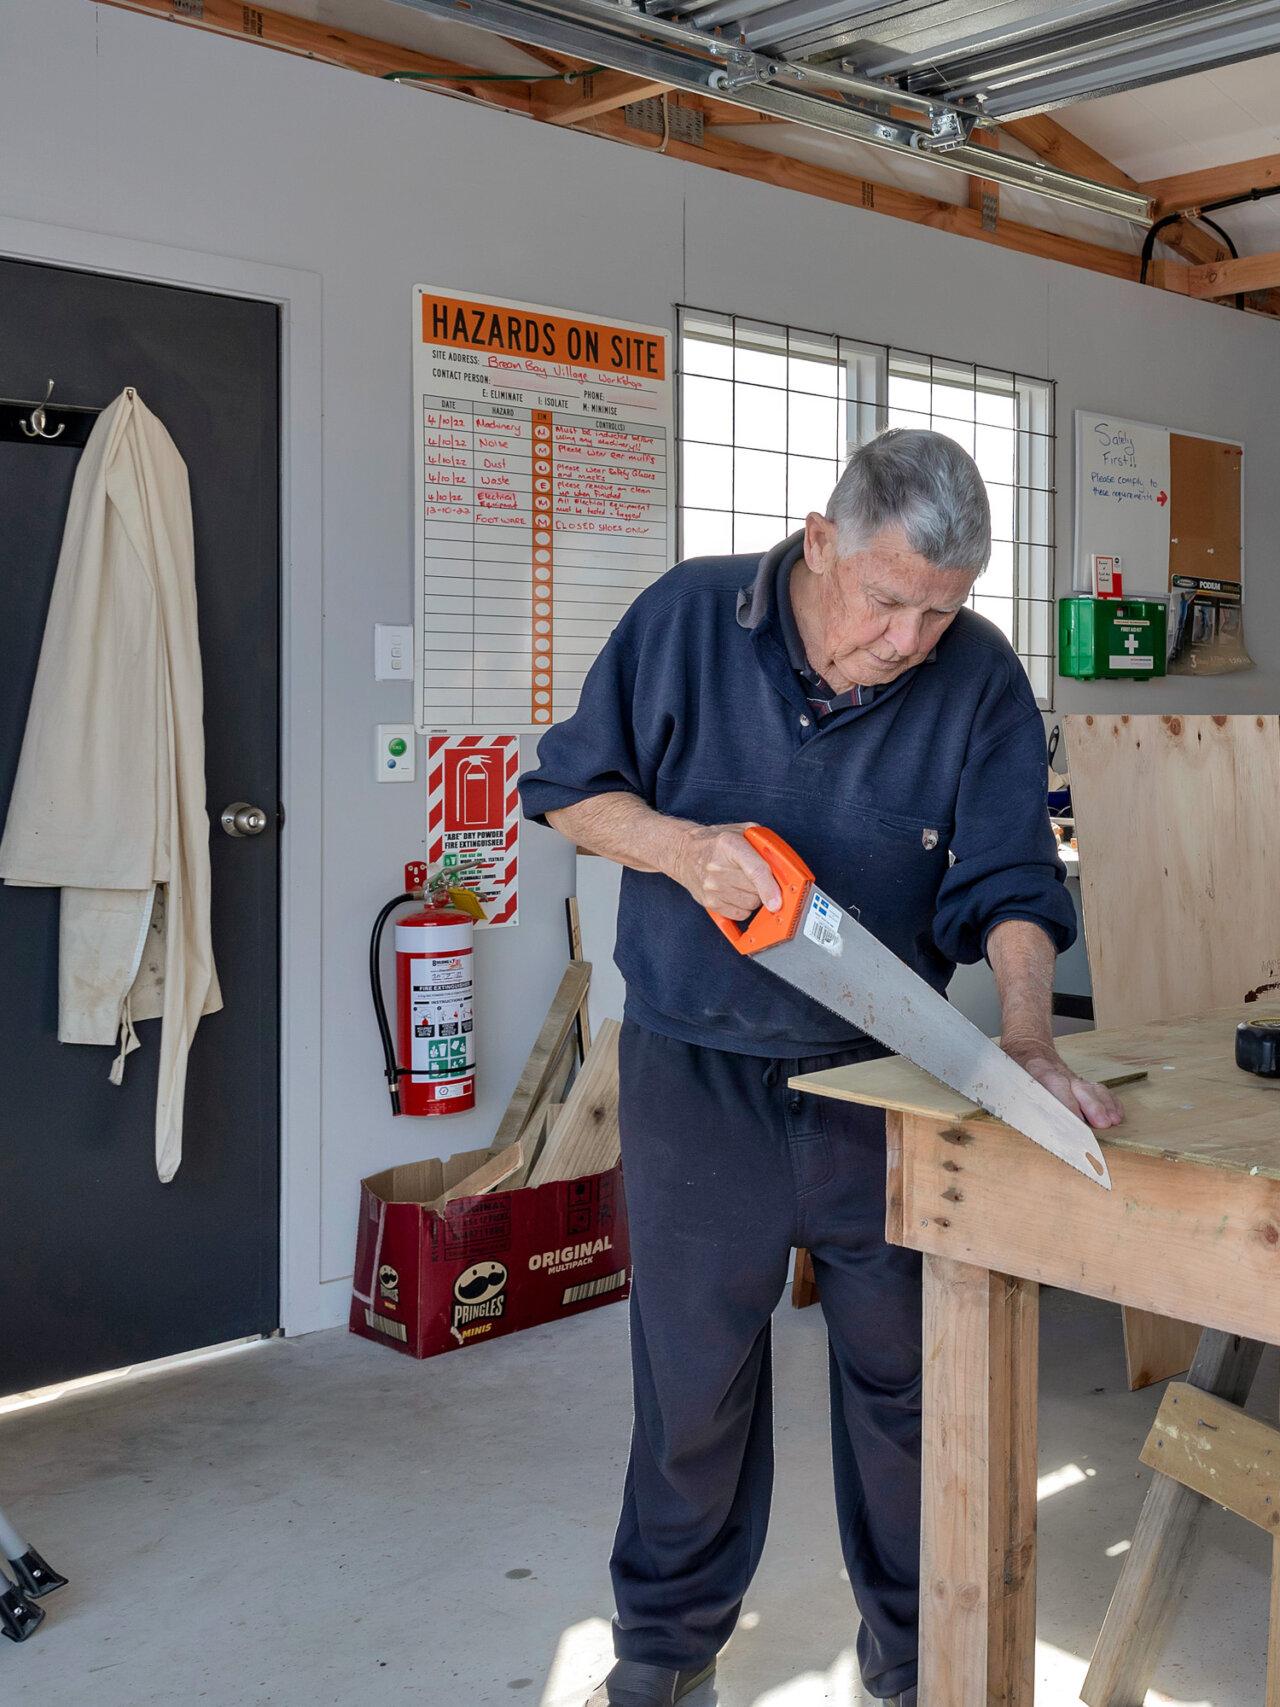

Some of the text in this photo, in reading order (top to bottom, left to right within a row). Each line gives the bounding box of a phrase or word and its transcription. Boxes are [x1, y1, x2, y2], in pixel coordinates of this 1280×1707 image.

[433, 304, 658, 374] HAZARDS ON SITE
[432, 350, 480, 365] SITE ADDRESS:
[433, 369, 491, 385] CONTACT PERSON:
[525, 360, 548, 379] Bay
[554, 367, 588, 384] Village
[490, 390, 523, 403] ELIMINATE
[584, 390, 604, 401] PHONE:
[442, 400, 457, 409] DATE
[545, 398, 569, 409] ISOLATE
[492, 407, 515, 417] HAZARD
[591, 404, 618, 416] MINIMISE
[1095, 423, 1136, 456] Safety
[539, 446, 547, 454] M
[484, 458, 506, 470] Dust
[538, 518, 548, 528] M
[556, 520, 595, 530] CLOSED
[598, 523, 622, 532] SHOES
[1199, 580, 1221, 591] PODIUM
[1190, 654, 1197, 668] 3
[464, 830, 475, 839] DRY
[477, 830, 504, 839] POWDER
[445, 838, 504, 849] FIRE EXTINGUISHER
[528, 1236, 613, 1271] ORIGINAL
[547, 1257, 593, 1275] MULTIPACK
[454, 1295, 505, 1328] PRINGLES
[463, 1323, 492, 1338] MINIS
